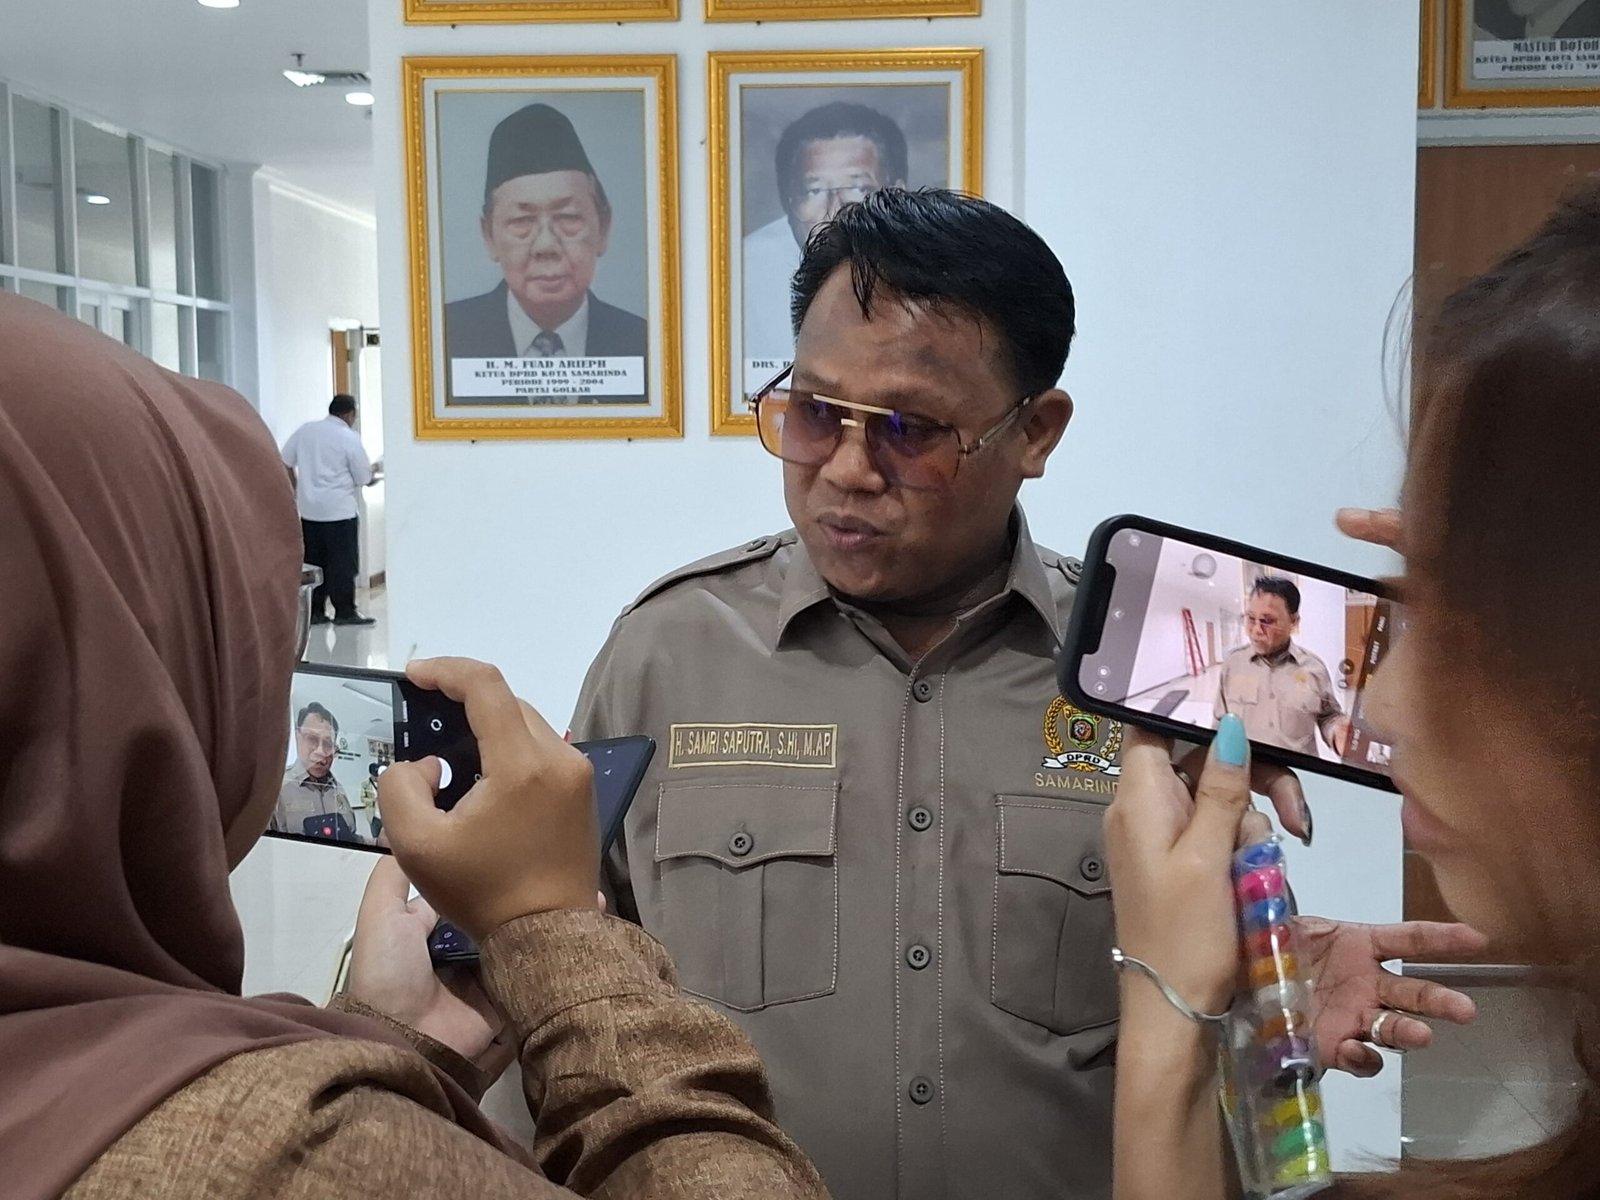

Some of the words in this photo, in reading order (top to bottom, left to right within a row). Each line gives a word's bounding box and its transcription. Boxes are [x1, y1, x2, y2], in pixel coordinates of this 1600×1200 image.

[486, 360, 499, 369] H.
[504, 360, 518, 369] M.
[522, 360, 553, 369] FUAD
[558, 360, 607, 369] ARIEPH
[752, 361, 778, 369] DRS.
[509, 370, 538, 378] DPRD
[687, 730, 721, 755] SAMRI
[723, 730, 773, 759] SAPUTRA,
[803, 732, 831, 757] M.AP
[1066, 754, 1101, 764] DPRD
